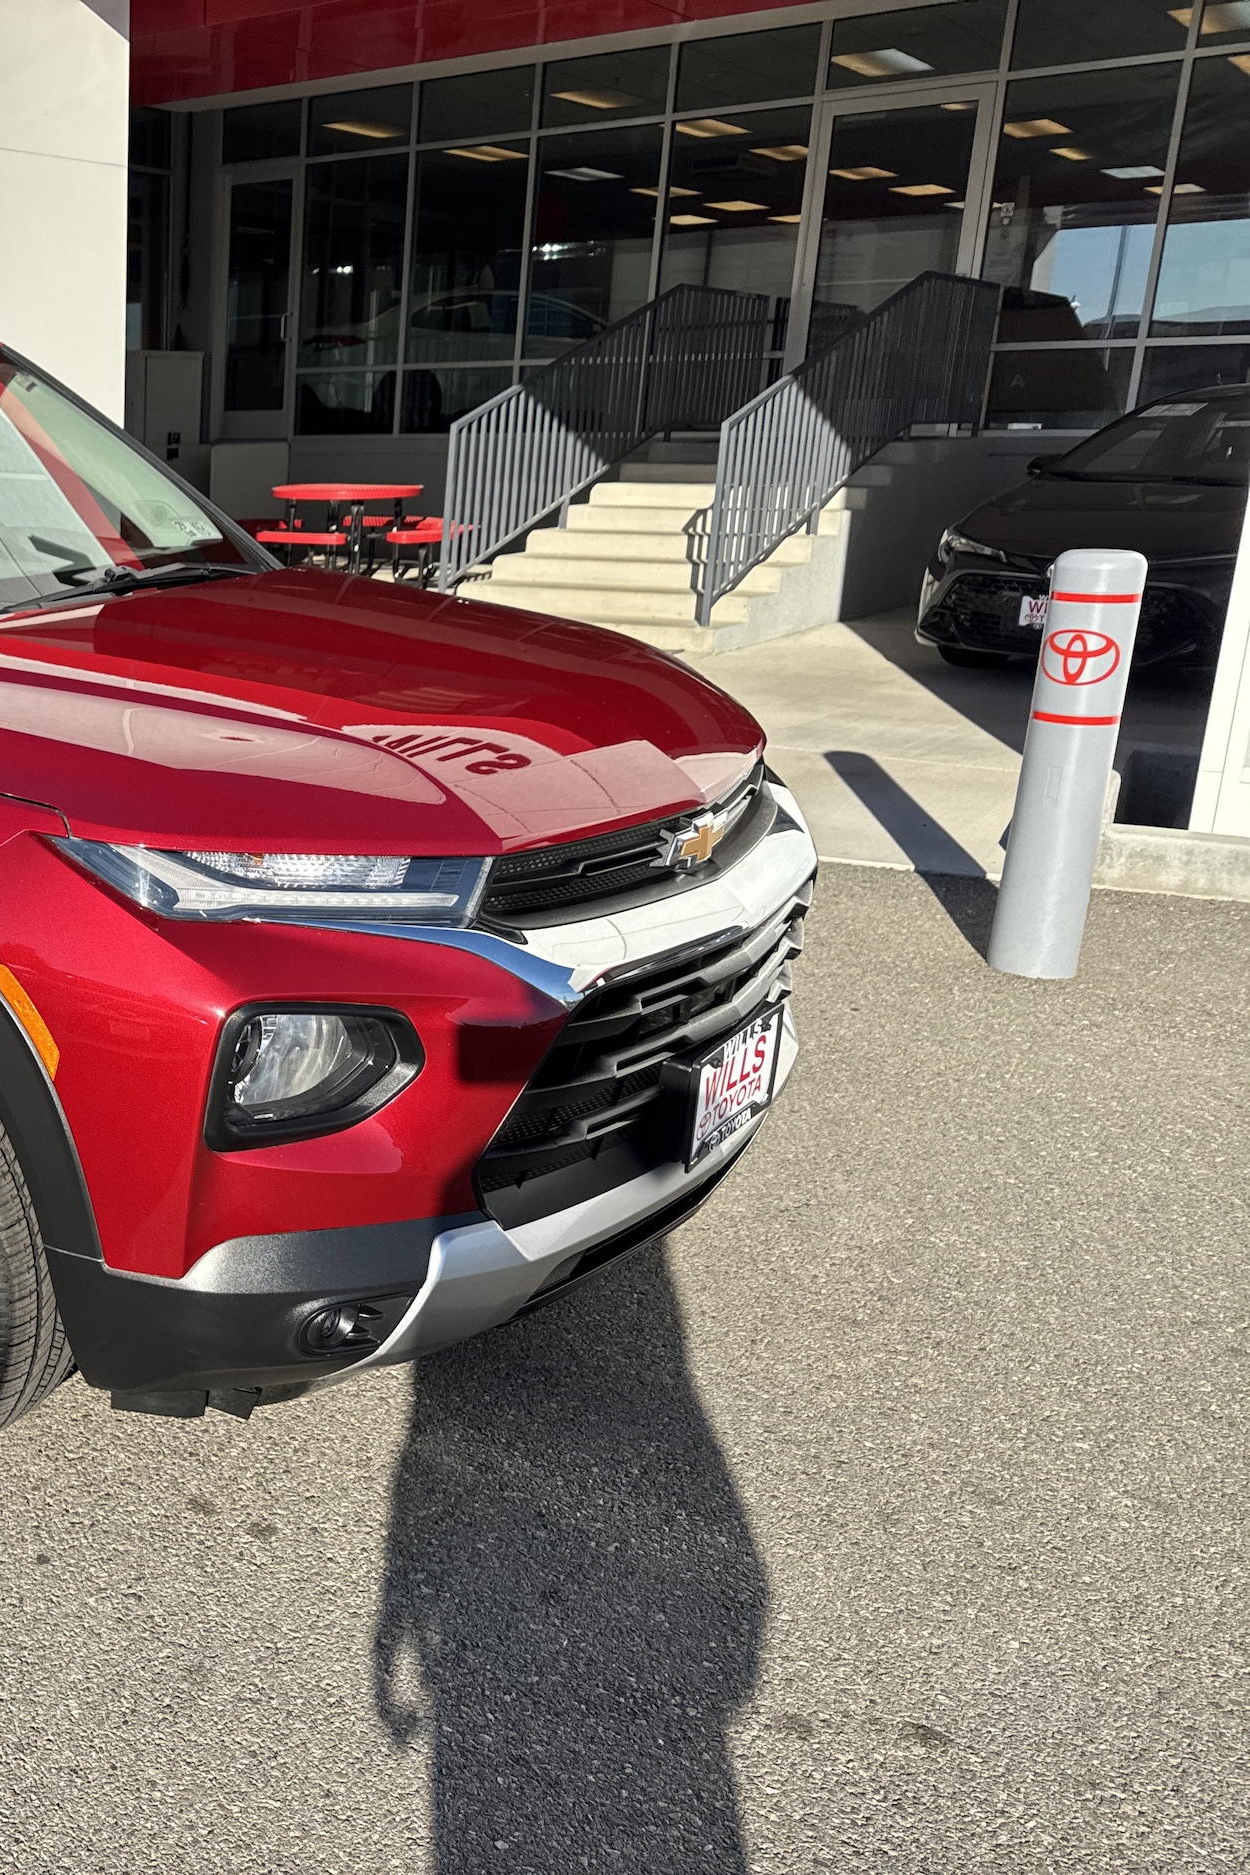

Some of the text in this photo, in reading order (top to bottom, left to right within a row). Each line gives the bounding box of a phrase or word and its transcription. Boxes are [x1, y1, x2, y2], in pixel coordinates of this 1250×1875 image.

[723, 1018, 763, 1060] WILLS
[705, 1035, 766, 1111] WILLS
[712, 1074, 761, 1125] TOYOTA
[721, 1107, 752, 1141] TOYOTA
